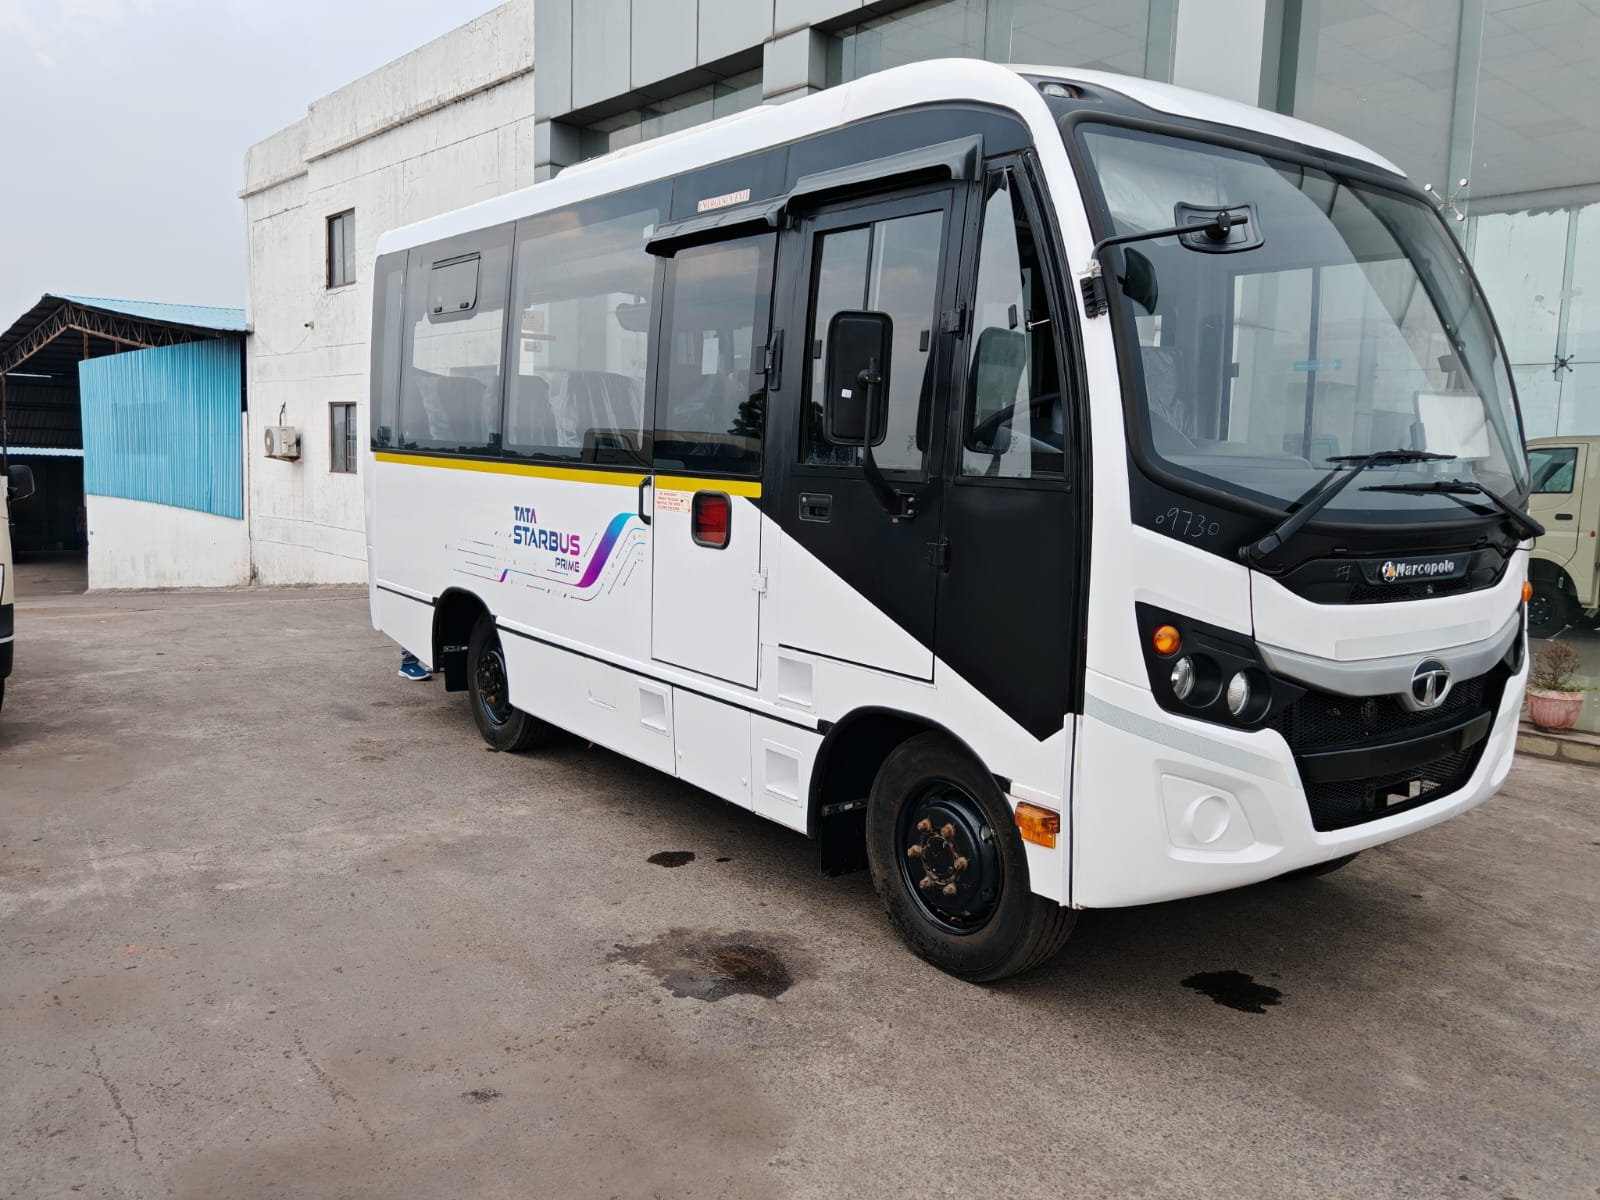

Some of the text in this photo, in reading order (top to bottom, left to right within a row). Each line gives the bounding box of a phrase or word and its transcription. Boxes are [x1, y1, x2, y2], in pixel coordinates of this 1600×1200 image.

[513, 505, 537, 524] TATA
[1155, 507, 1220, 537] 09730
[513, 525, 580, 556] STARBUS
[555, 557, 580, 573] PRIME
[1395, 559, 1454, 577] Marcopolo
